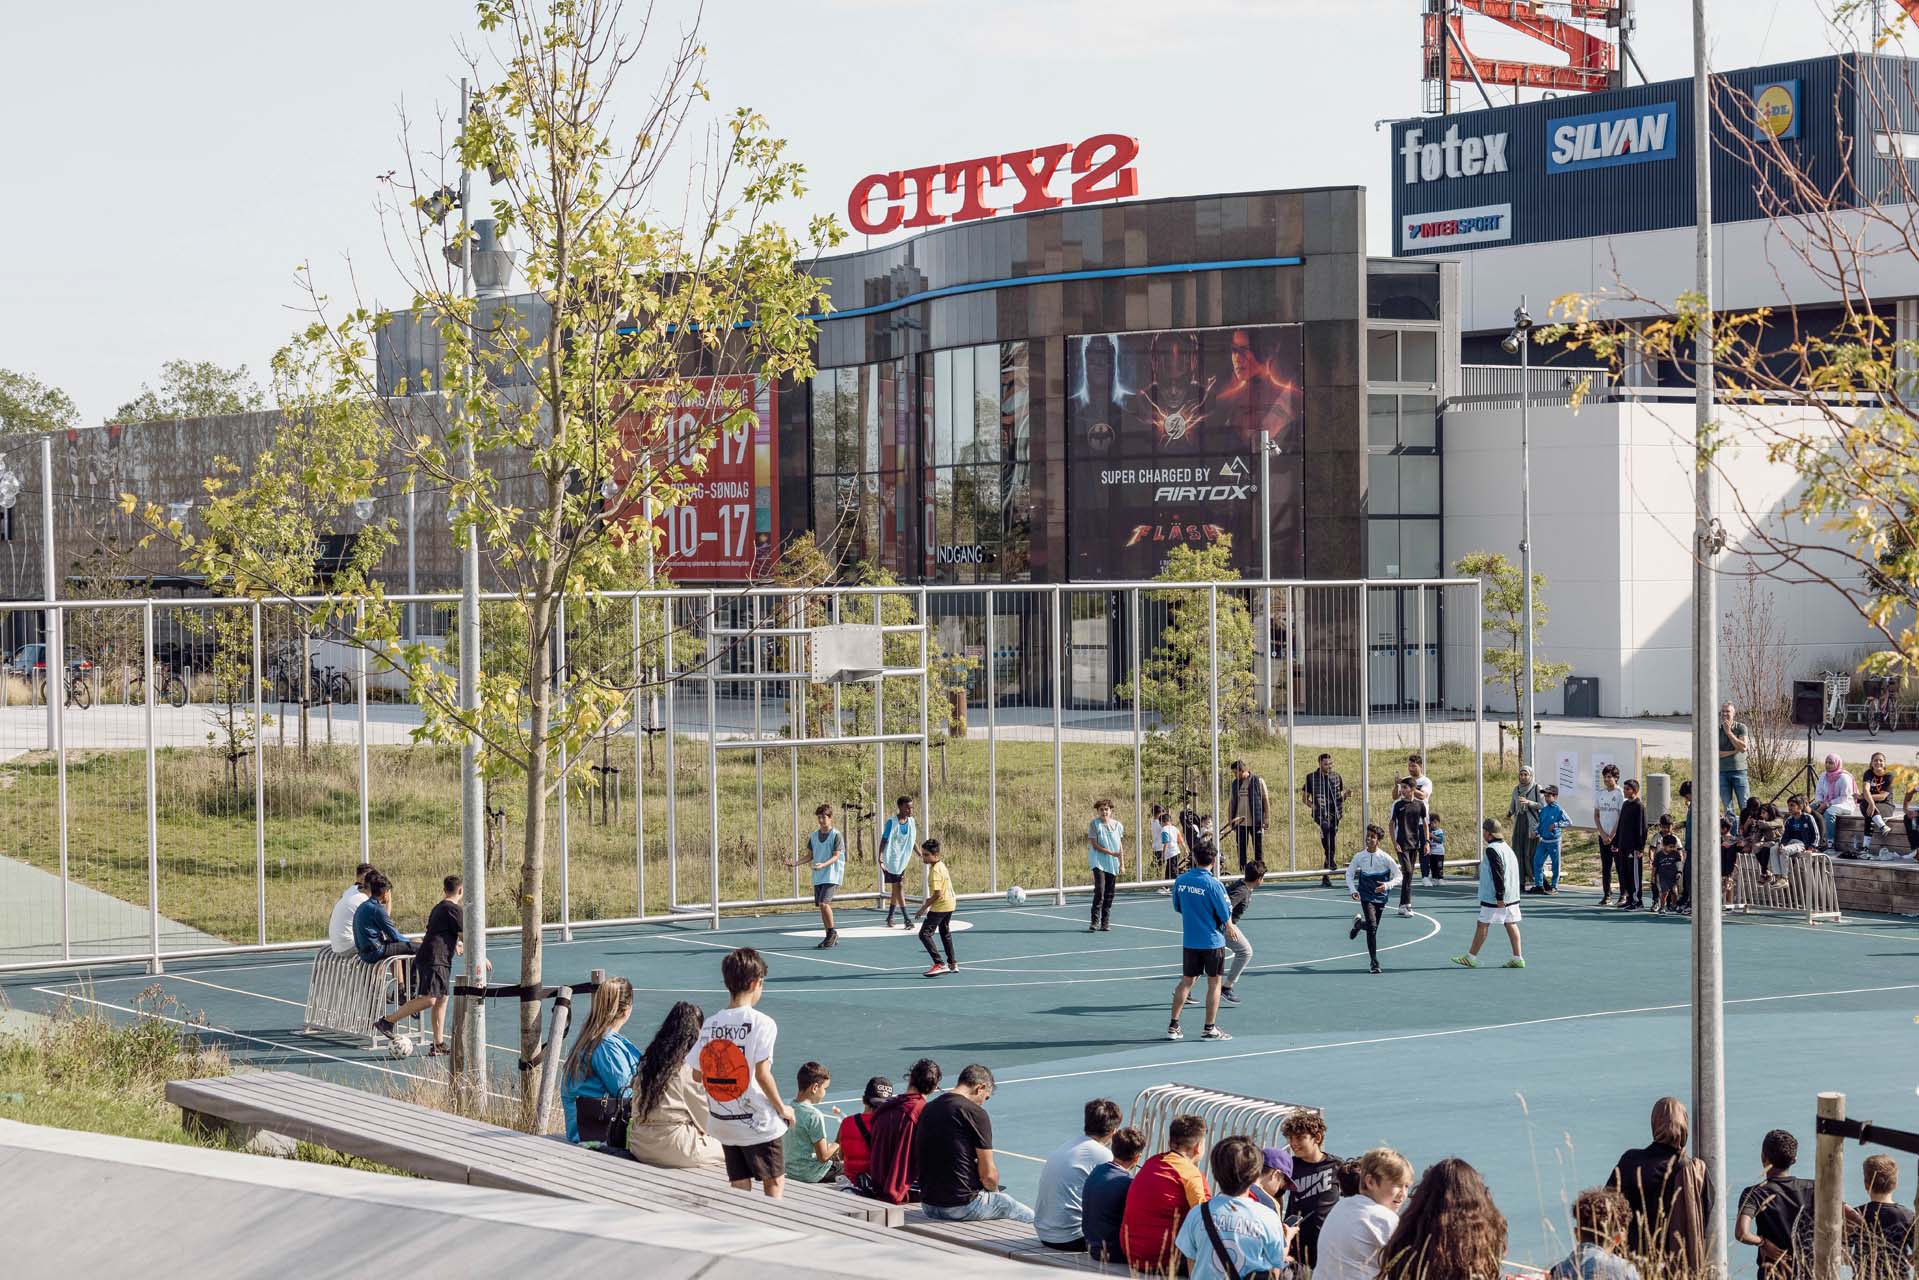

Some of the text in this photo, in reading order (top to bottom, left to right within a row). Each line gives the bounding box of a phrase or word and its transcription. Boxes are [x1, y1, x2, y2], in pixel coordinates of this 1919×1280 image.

[1551, 113, 1668, 165] SILVAN
[1400, 124, 1509, 185] føtex
[848, 133, 1140, 235] CITY2
[1420, 215, 1501, 238] INTERSPORT
[1101, 467, 1210, 485] SUPER CHARGED BY
[667, 481, 749, 499] ØRDAG-SØNDAG
[663, 503, 750, 558] 10-17
[937, 545, 982, 563] INDGANG
[1186, 886, 1206, 896] YONEX
[711, 1026, 747, 1040] TOKYO
[1295, 1168, 1333, 1198] NIKE
